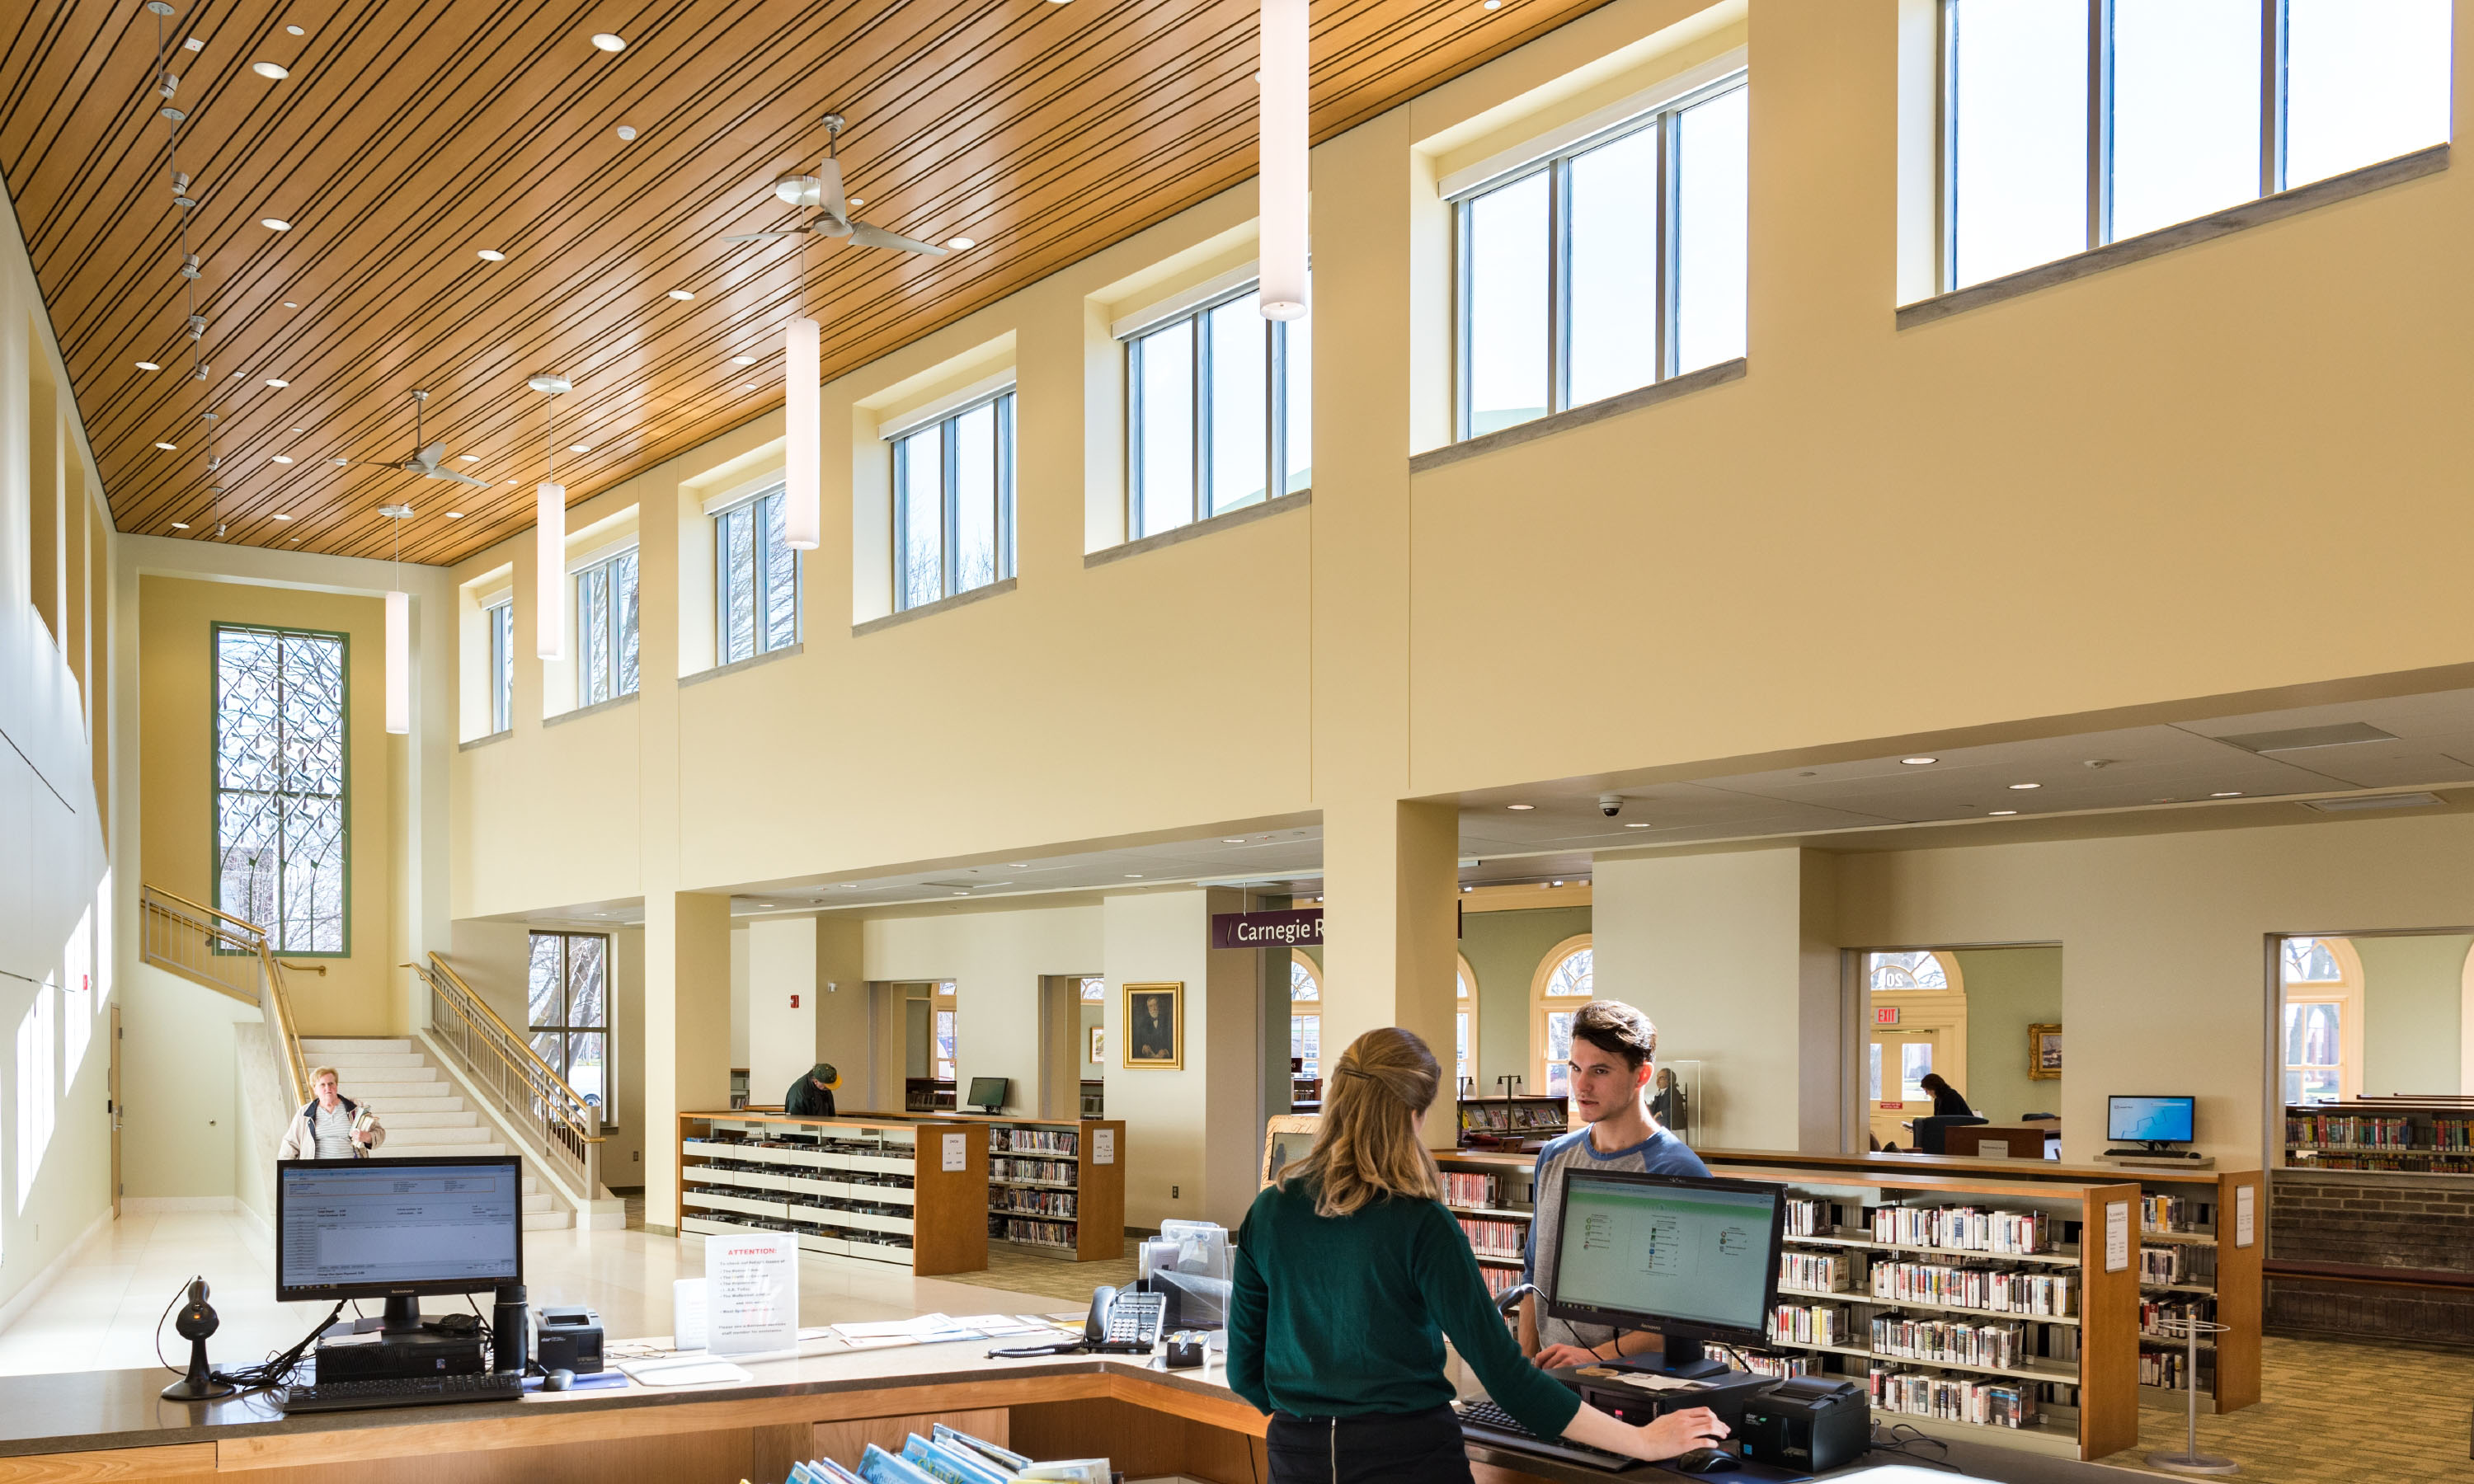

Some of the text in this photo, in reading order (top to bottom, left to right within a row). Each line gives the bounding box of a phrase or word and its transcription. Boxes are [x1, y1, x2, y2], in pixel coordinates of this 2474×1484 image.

[1237, 918, 1310, 944] Carnegie
[1878, 1008, 1896, 1022] EXIT
[727, 1247, 778, 1256] ATTENTION:
